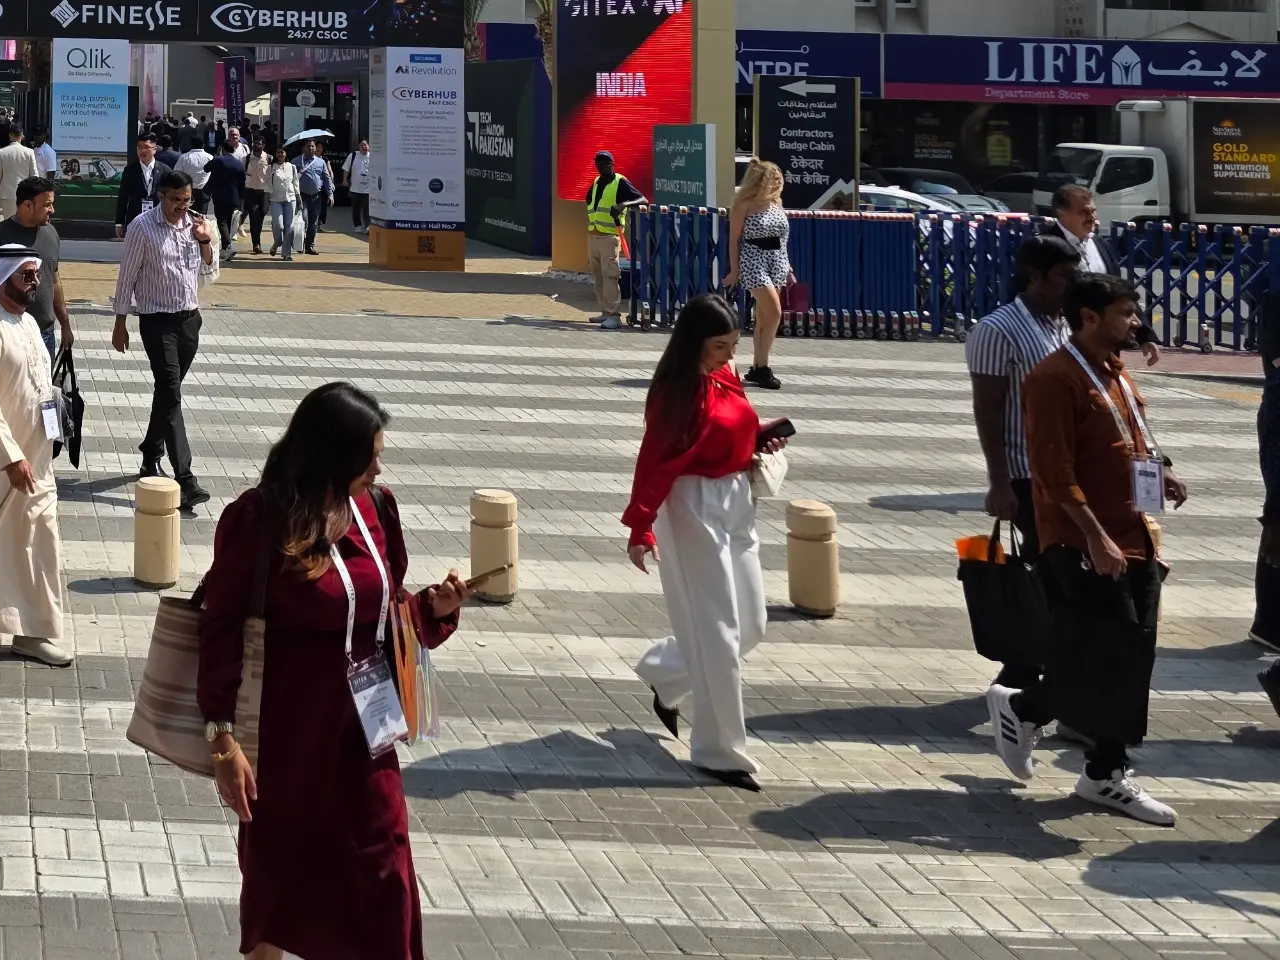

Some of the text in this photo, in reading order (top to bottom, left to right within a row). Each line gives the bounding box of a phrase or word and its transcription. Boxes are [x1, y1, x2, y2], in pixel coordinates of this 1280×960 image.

[81, 0, 181, 31] FINESSE
[228, 9, 348, 29] CYBERHUB
[287, 30, 348, 39] 24x7 CSOC
[984, 41, 1105, 84] LIFE
[1147, 48, 1268, 87] لايف
[411, 66, 457, 75] Revolution
[596, 72, 647, 97] INDIA
[399, 89, 457, 99] CYBERHUB
[985, 88, 1090, 100] Department Store
[60, 102, 121, 110] way-too-much data
[778, 100, 837, 109] استلام بطاقات
[480, 112, 492, 123] TECH
[788, 111, 826, 119] المقاولين
[780, 128, 833, 138] Contractors
[479, 136, 514, 158] PAKISTAN
[779, 141, 835, 151] Badge Cabin
[1213, 143, 1248, 152] GOLD
[790, 155, 825, 169] ठेकेदार
[1213, 152, 1276, 162] STANDARD
[466, 168, 481, 177] MINISTRY
[482, 169, 487, 178] OF
[495, 171, 512, 182] TELECOM
[1213, 171, 1271, 179] SUPPLEMENTS
[655, 178, 703, 195] ENTRANCE TO DWTC
